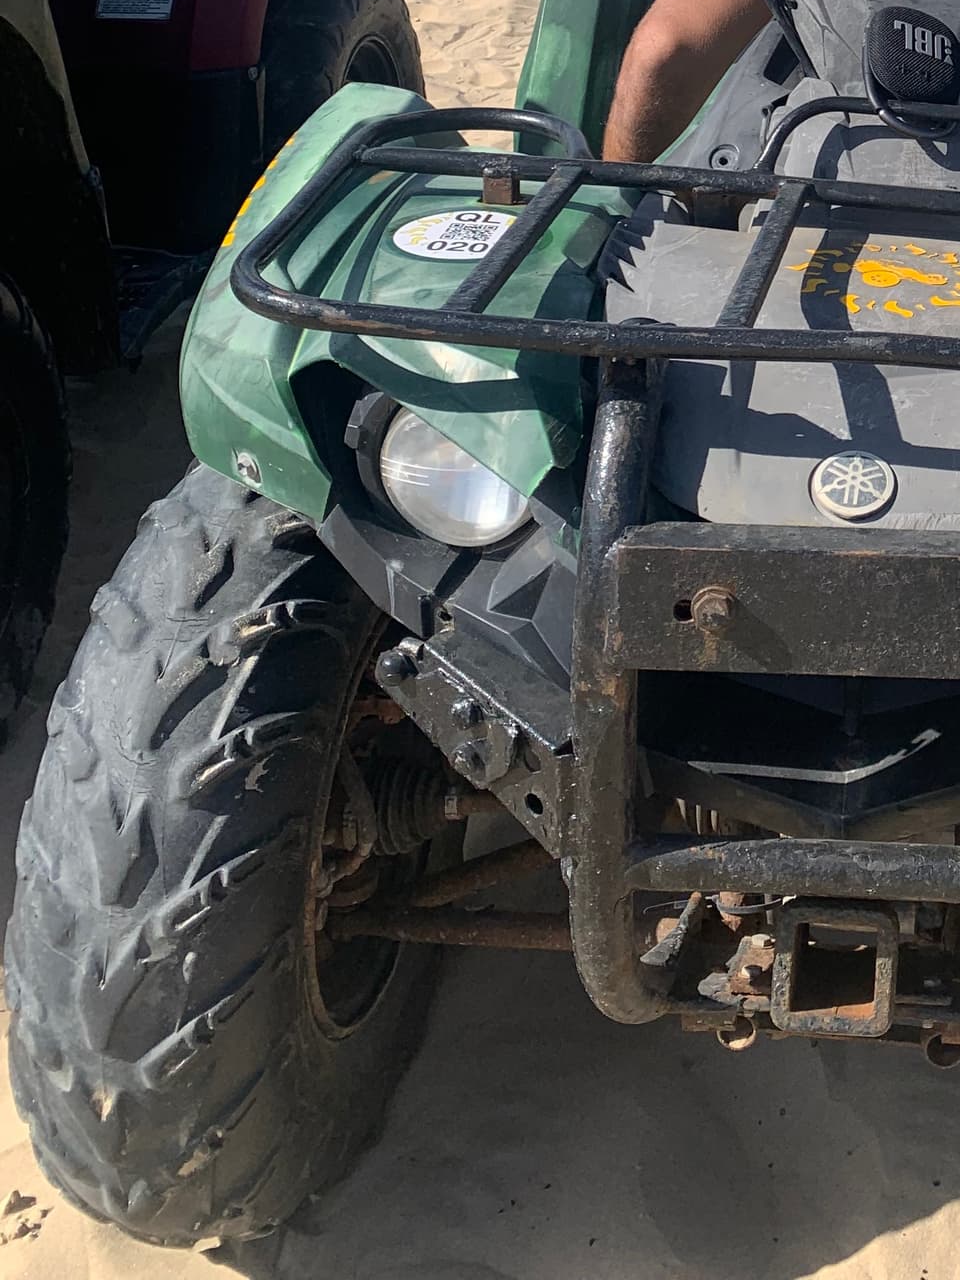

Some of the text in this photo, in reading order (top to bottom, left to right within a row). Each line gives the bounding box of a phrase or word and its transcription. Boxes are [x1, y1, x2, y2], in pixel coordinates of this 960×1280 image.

[894, 20, 954, 66] JBL
[455, 212, 502, 224] QL
[427, 240, 489, 253] 020
